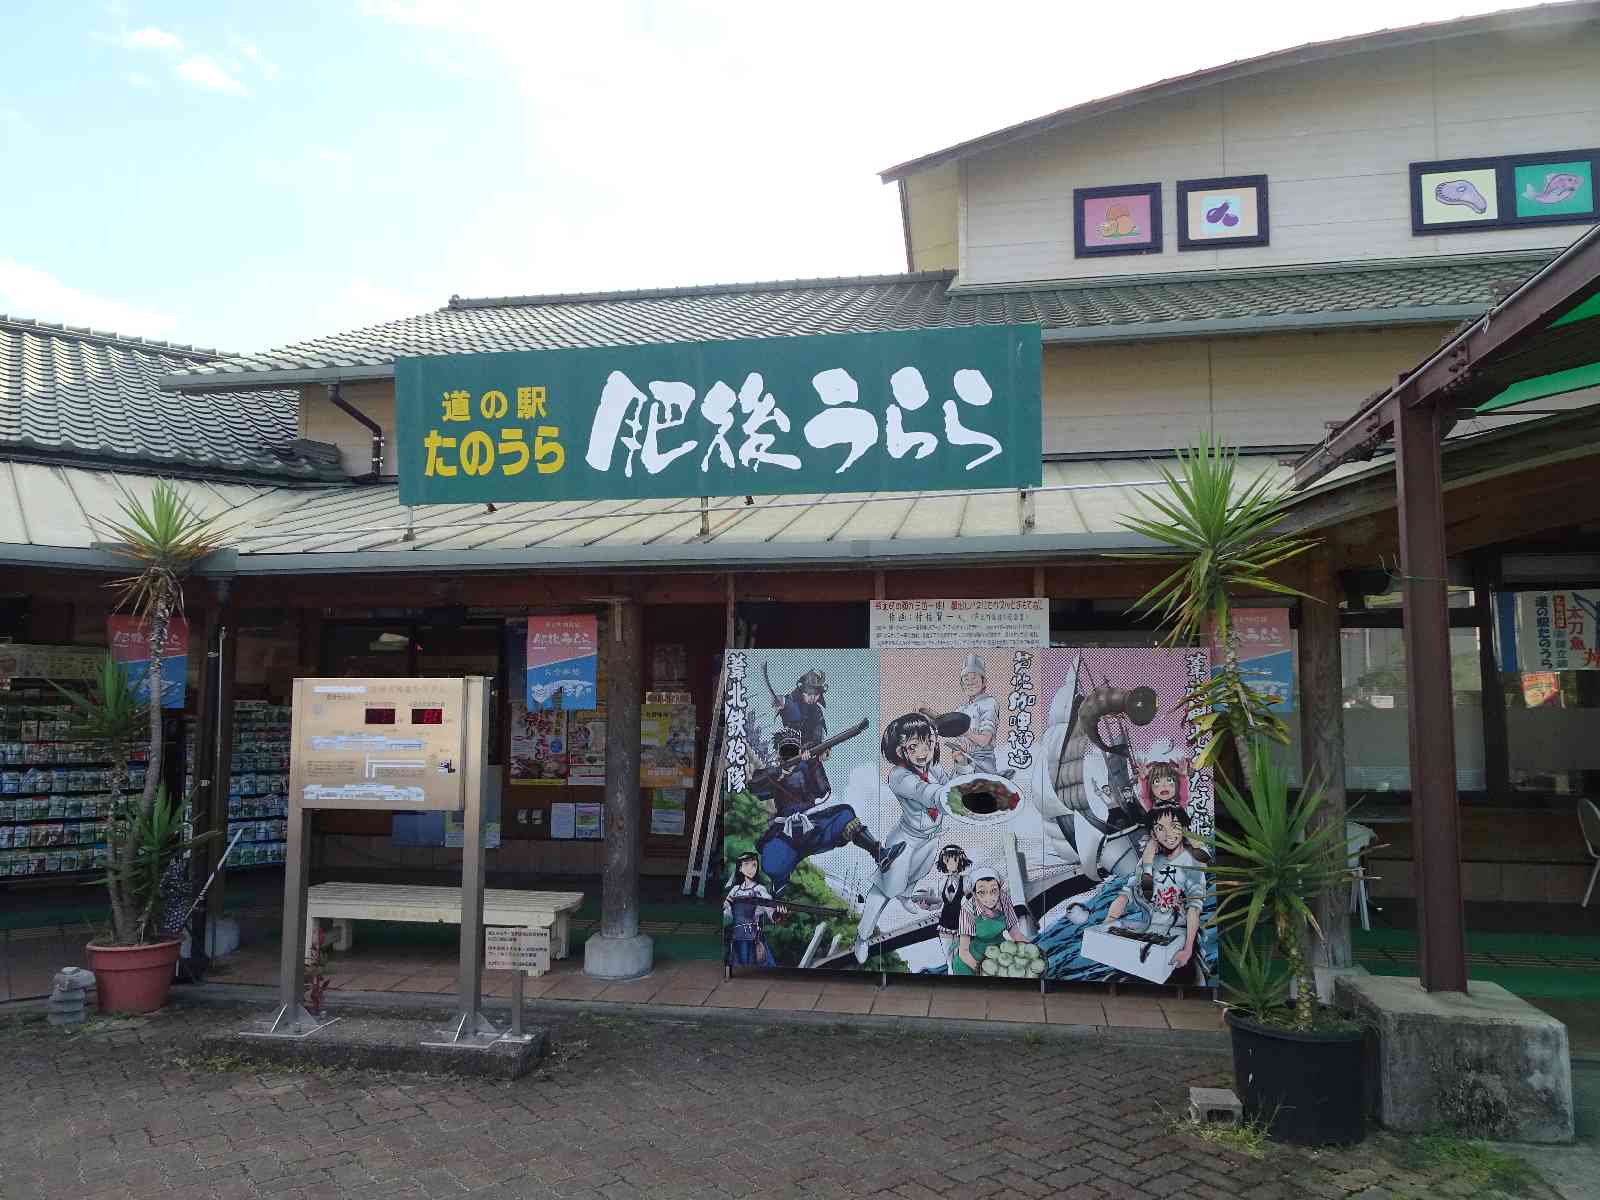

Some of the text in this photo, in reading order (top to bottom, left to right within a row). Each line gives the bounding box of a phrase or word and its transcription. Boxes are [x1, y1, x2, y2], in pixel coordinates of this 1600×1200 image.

[442, 386, 547, 421] 道の駅
[585, 367, 1003, 479] 肥後うらら
[424, 425, 565, 476] たのうら
[726, 651, 748, 794] 葦北鉄砲隊
